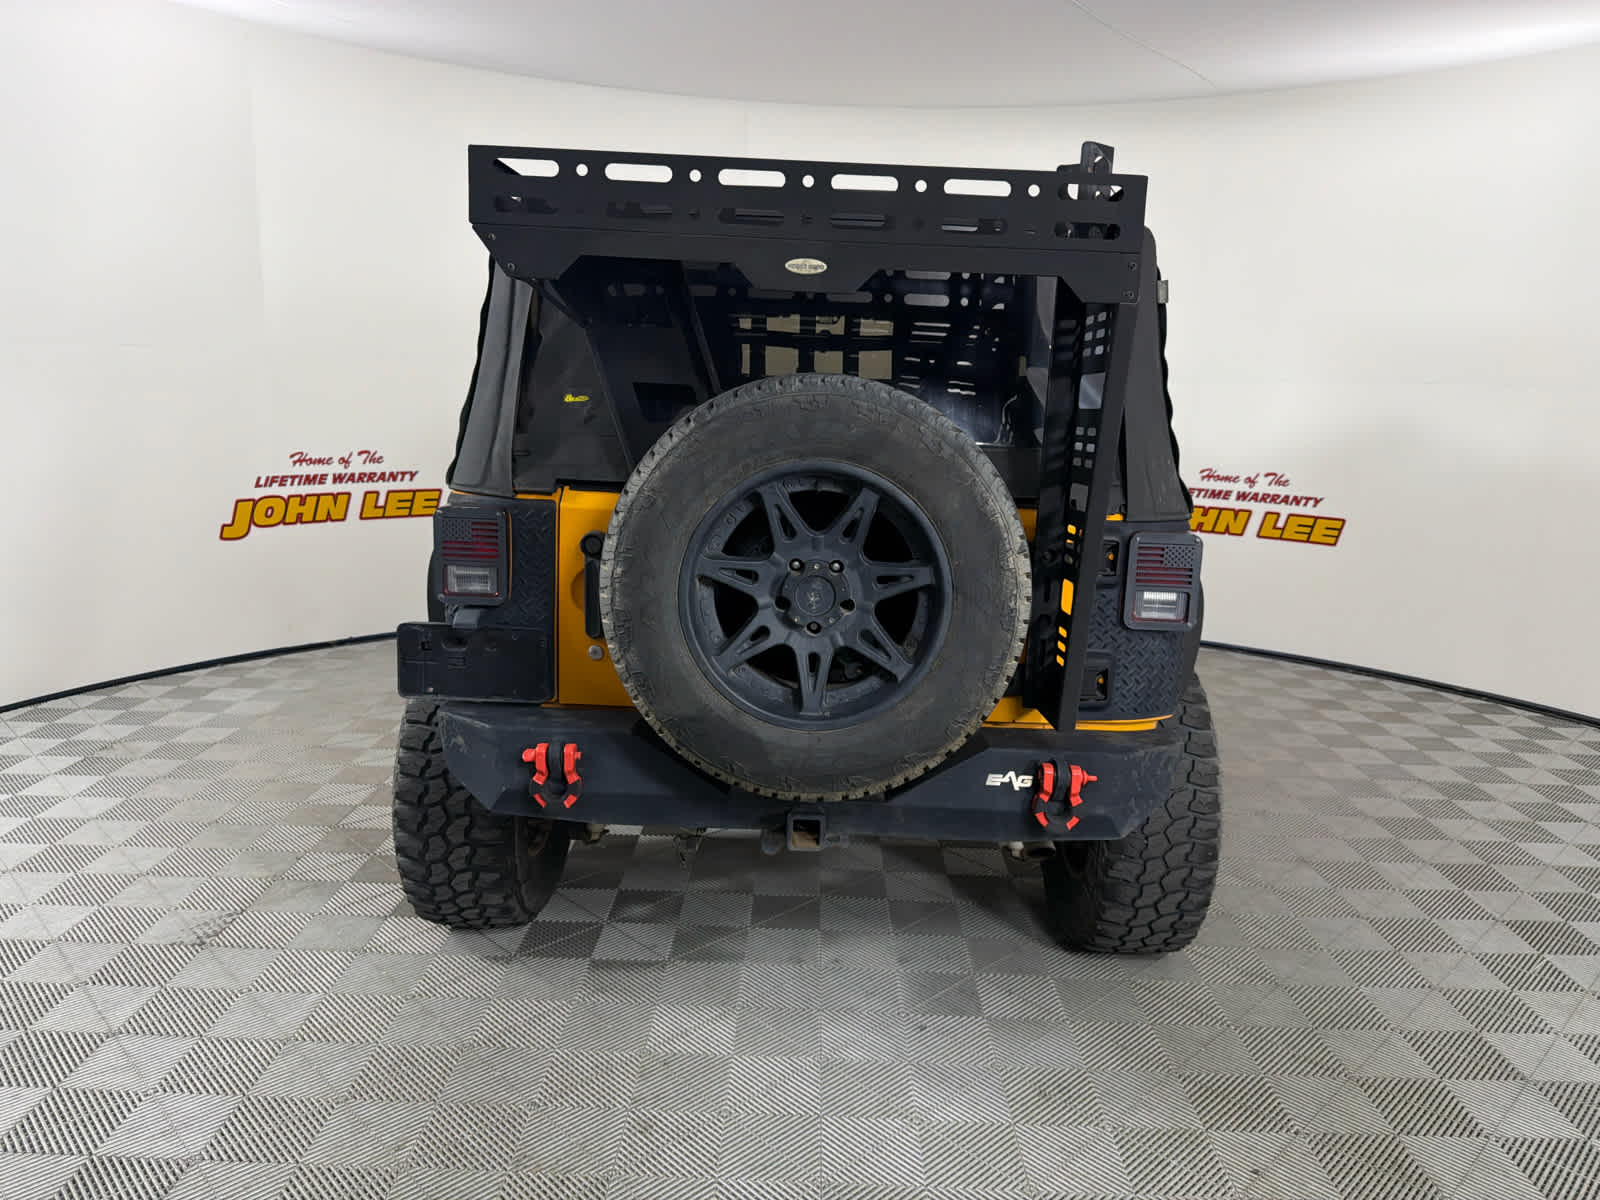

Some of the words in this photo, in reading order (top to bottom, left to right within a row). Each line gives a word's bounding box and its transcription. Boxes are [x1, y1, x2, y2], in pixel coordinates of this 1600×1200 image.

[289, 451, 334, 467] Home
[338, 451, 351, 468] of
[357, 450, 384, 465] The
[254, 473, 328, 488] LIFETIME
[332, 470, 418, 485] WARRANTY
[1200, 468, 1240, 484] Home
[1244, 473, 1260, 489] of
[1264, 472, 1291, 487] The
[1236, 490, 1325, 508] WARRANTY
[219, 492, 351, 541] JOHN
[359, 488, 442, 520] LEE
[1256, 511, 1346, 547] LEE
[985, 770, 1033, 791] EAG
